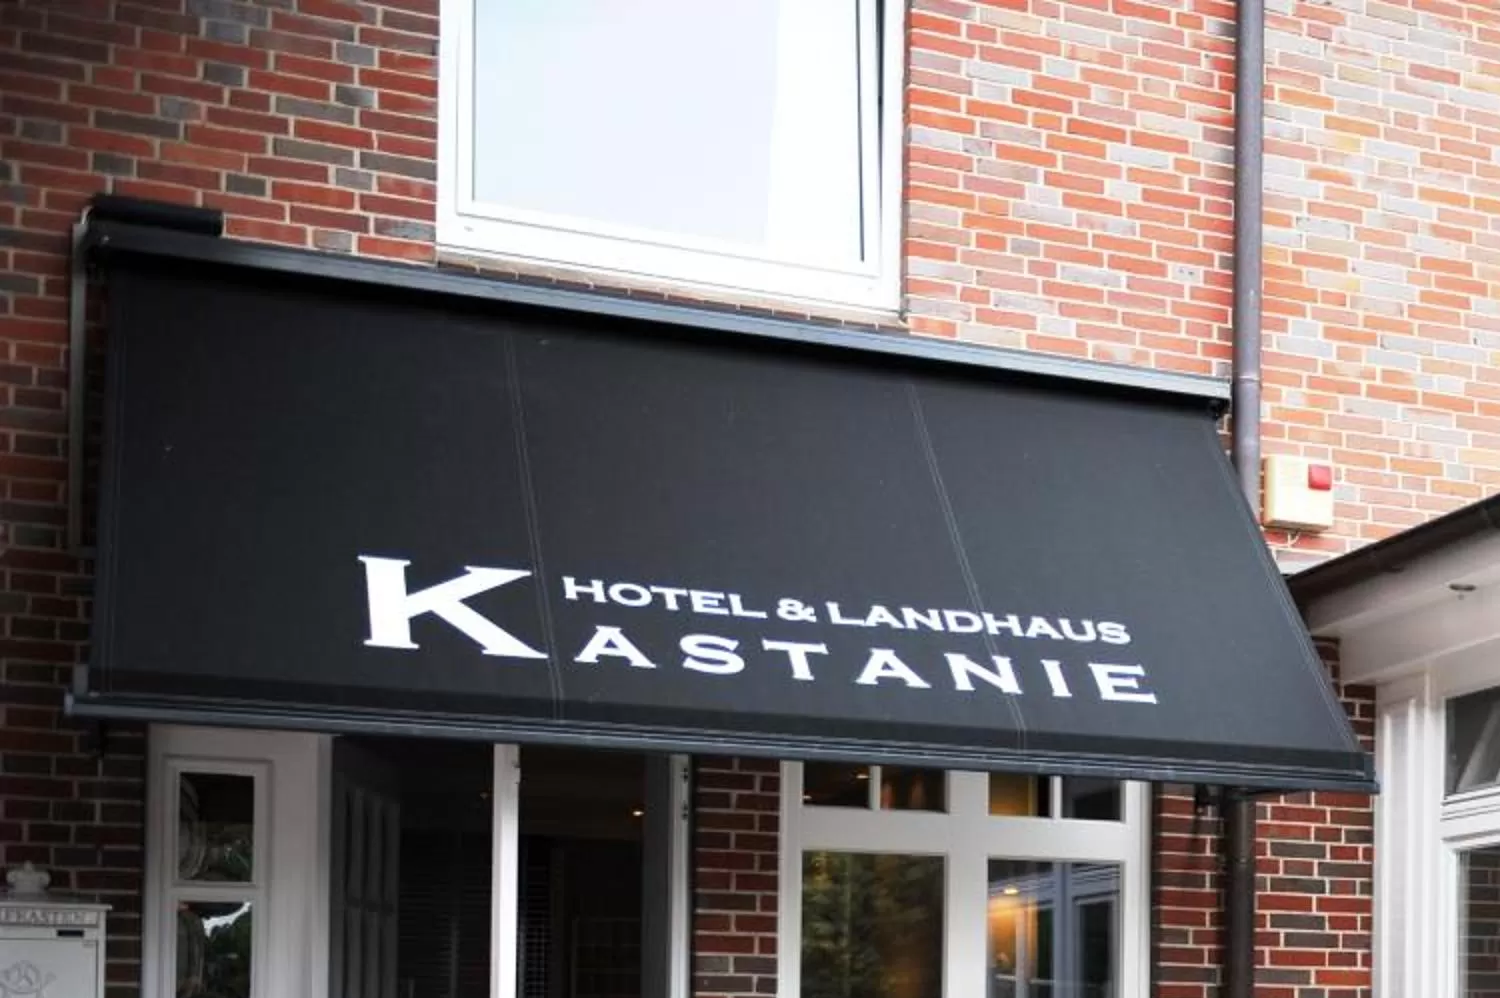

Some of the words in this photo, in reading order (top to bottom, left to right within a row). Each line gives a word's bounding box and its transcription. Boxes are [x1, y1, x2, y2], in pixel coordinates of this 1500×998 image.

[358, 556, 1157, 704] KASTANIE
[563, 577, 767, 618] HOTEL
[777, 598, 817, 622] &
[826, 602, 1130, 644] LANDHAUS
